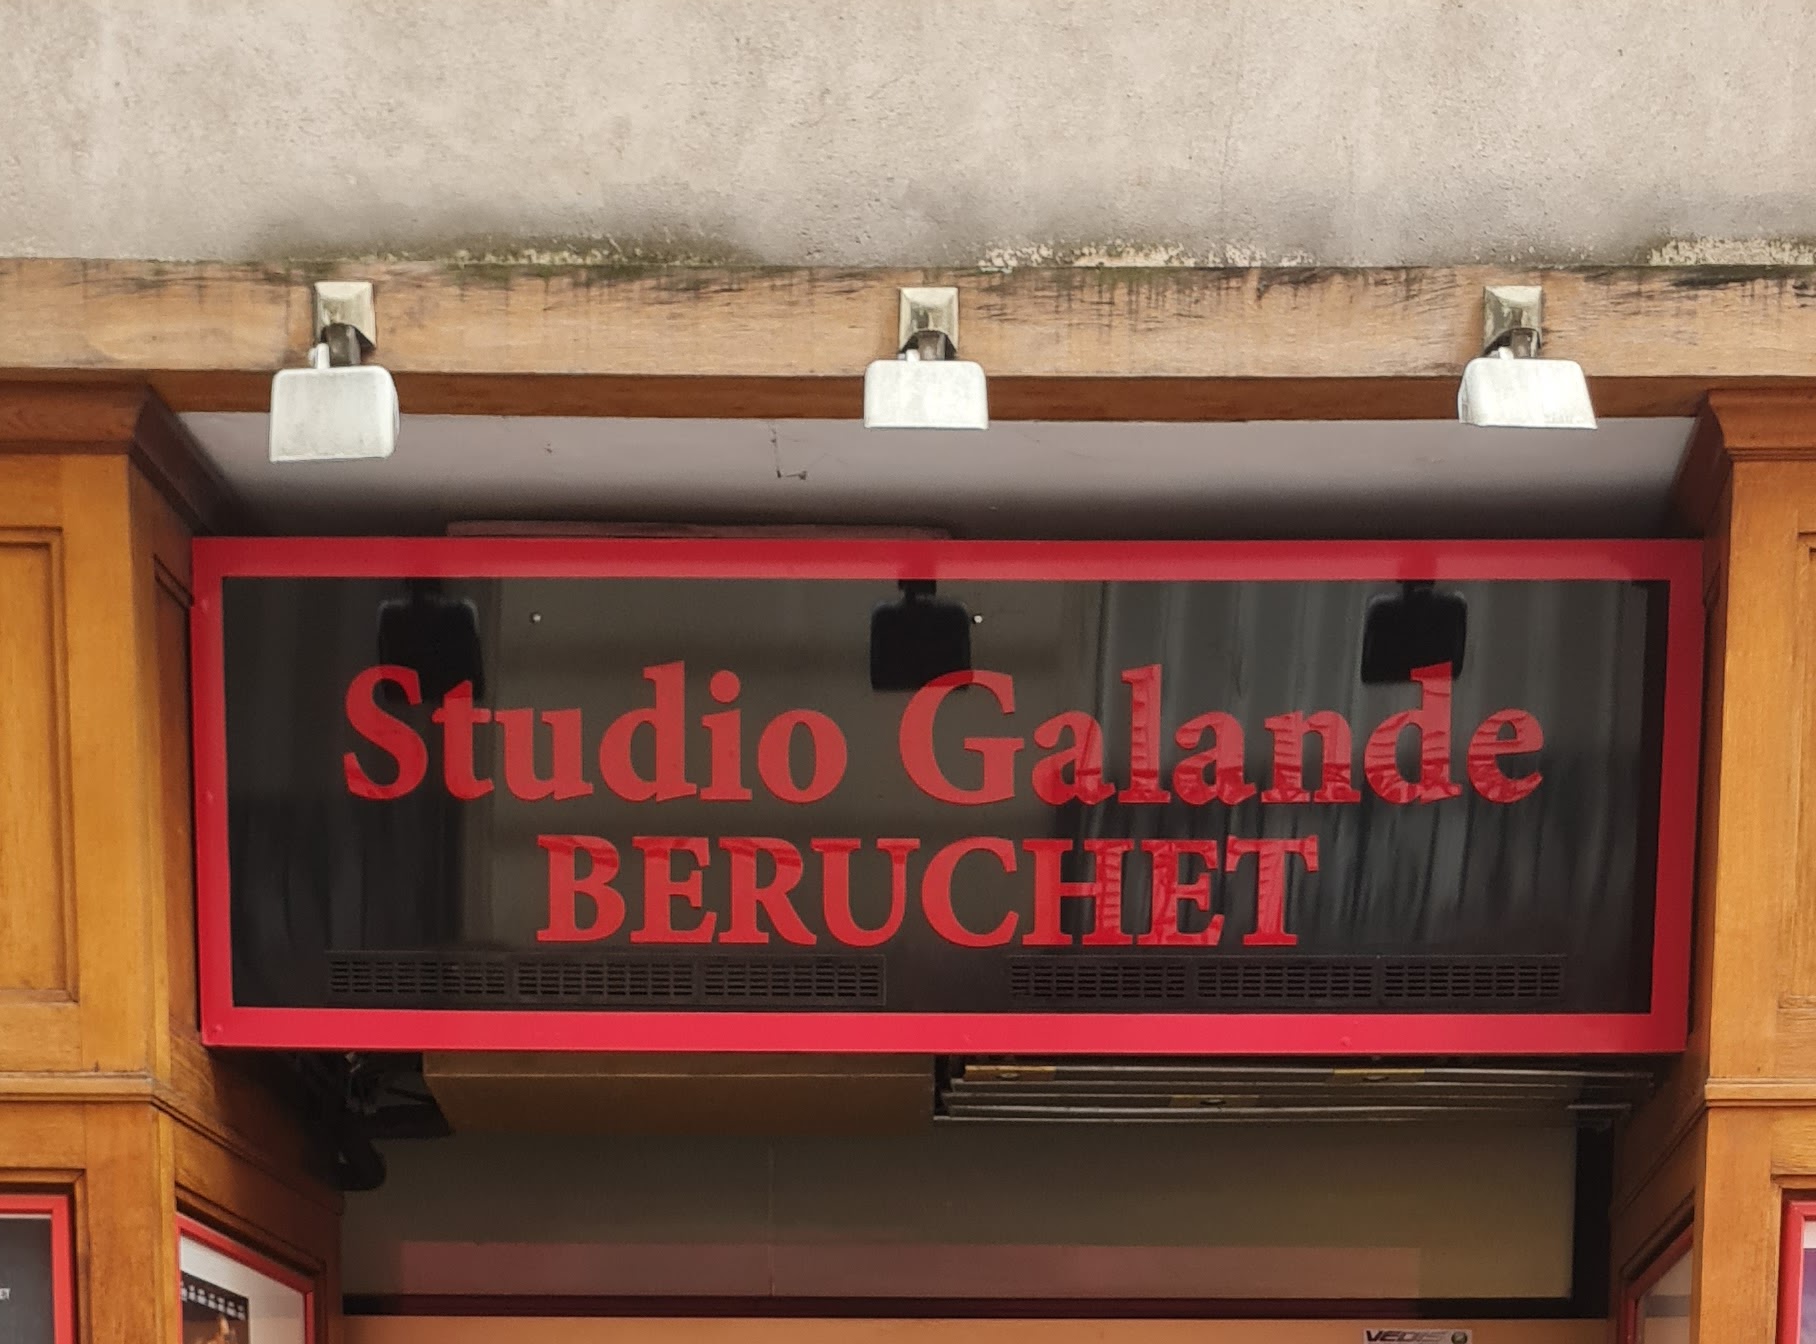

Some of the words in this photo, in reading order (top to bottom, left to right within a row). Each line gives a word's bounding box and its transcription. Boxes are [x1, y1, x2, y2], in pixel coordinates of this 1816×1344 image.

[343, 661, 848, 803] Studio
[899, 661, 1545, 806] Galande
[535, 833, 1320, 947] BERUCHET
